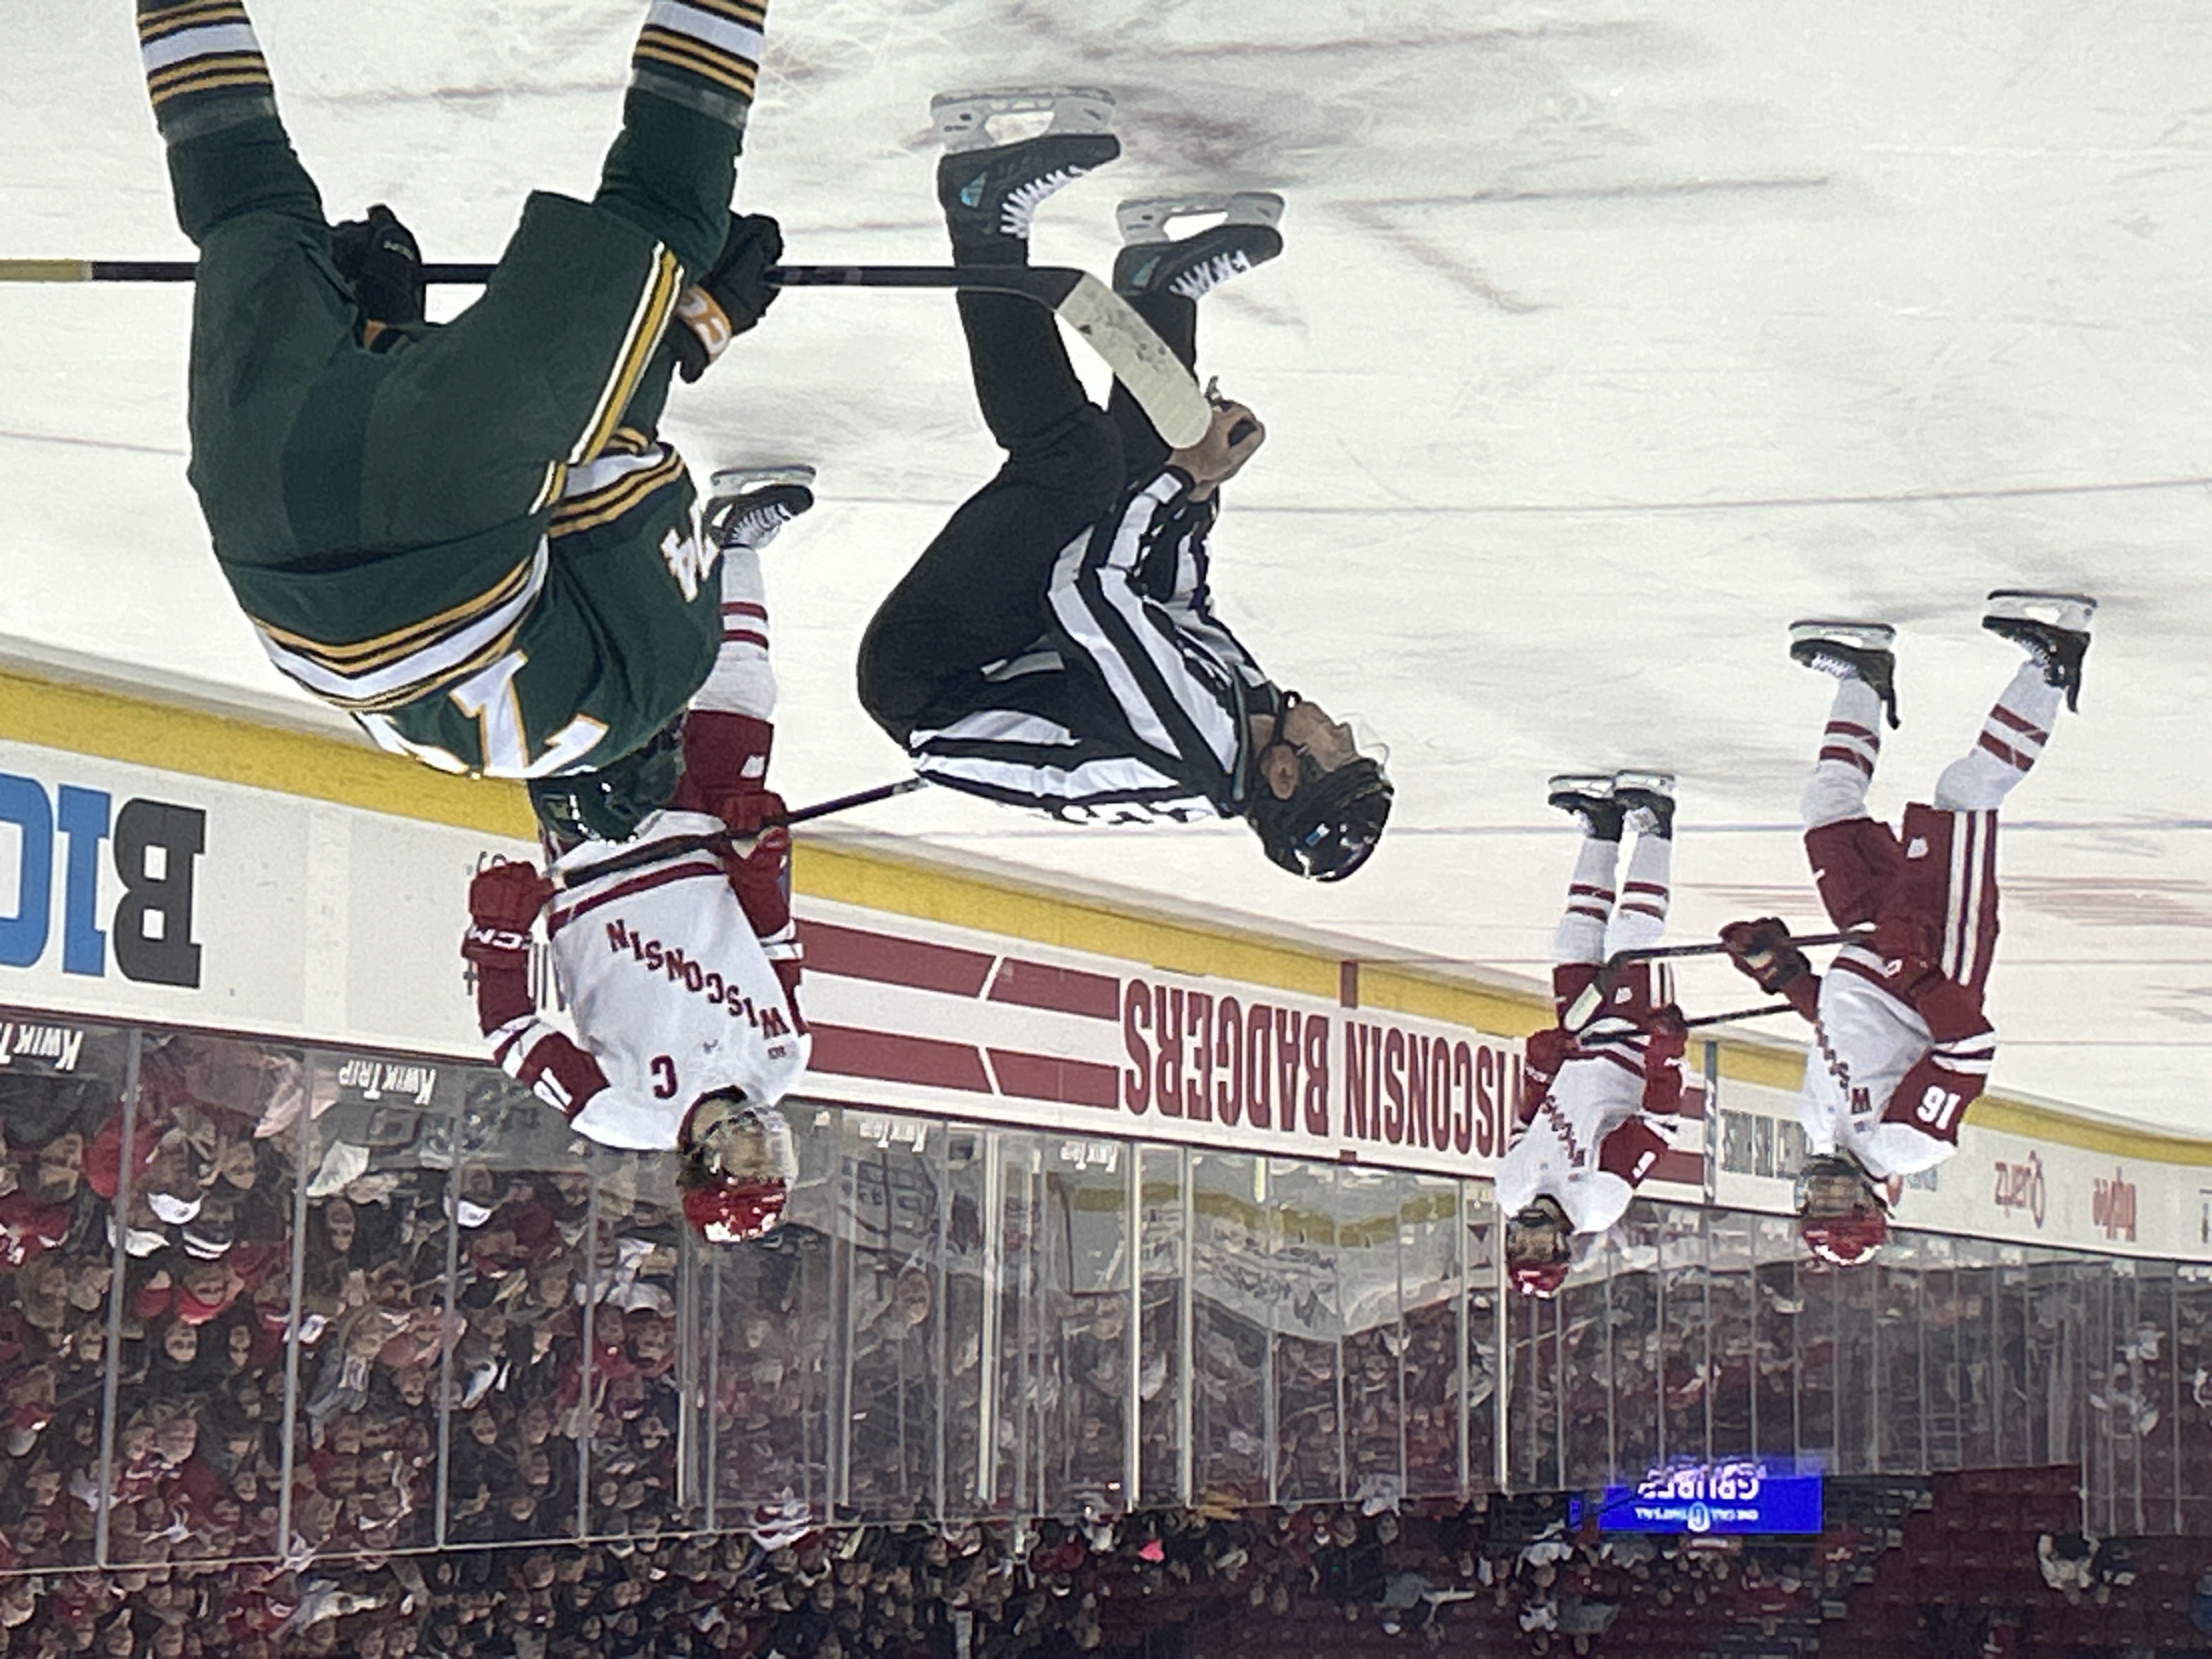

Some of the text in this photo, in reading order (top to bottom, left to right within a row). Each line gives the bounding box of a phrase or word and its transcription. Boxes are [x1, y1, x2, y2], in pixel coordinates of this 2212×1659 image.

[606, 919, 790, 1040] WISCONSIN
[651, 1055, 678, 1100] C
[1124, 979, 1329, 1138] BADGERS
[1917, 1085, 1961, 1130] 16
